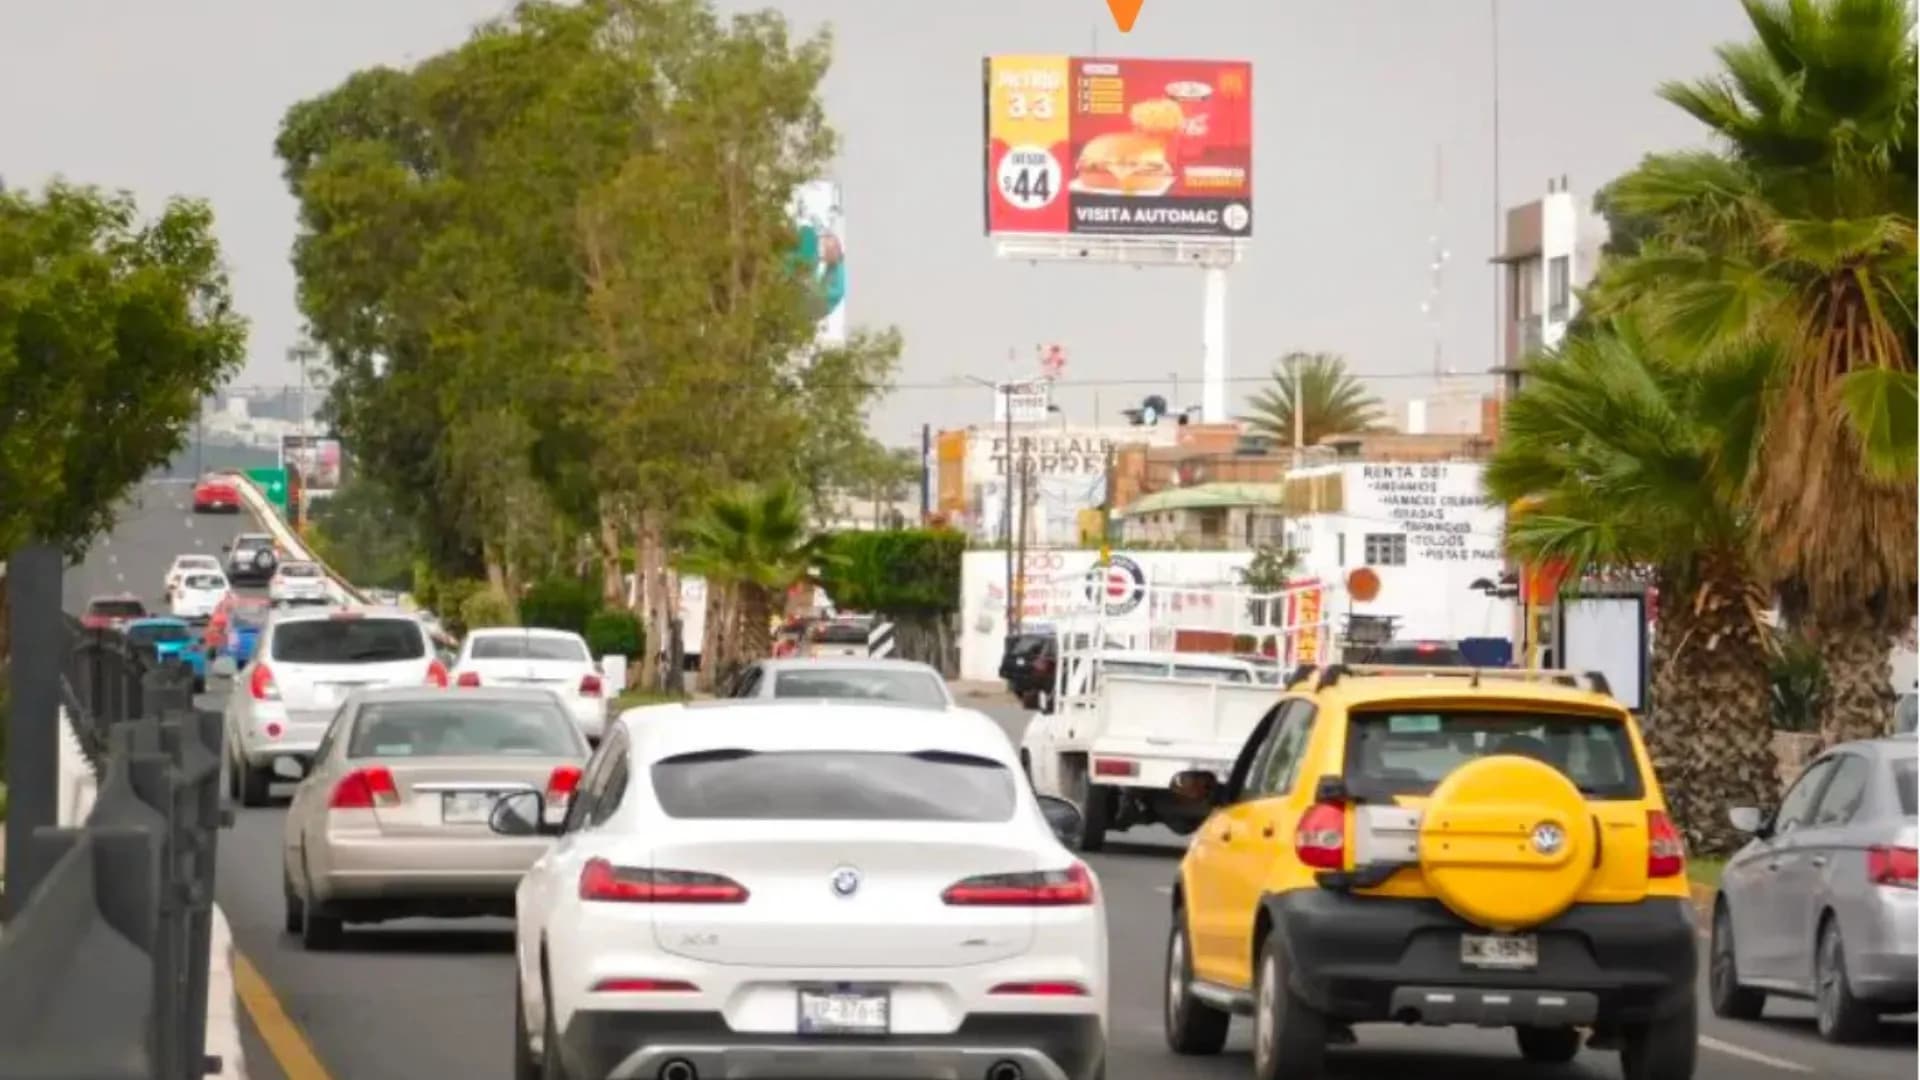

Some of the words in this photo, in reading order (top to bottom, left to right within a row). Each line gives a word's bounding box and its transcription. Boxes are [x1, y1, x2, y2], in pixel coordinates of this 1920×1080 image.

[1076, 206, 1131, 222] VISITA
[1135, 207, 1219, 224] AUTOMAC
[1363, 466, 1414, 479] RENTA
